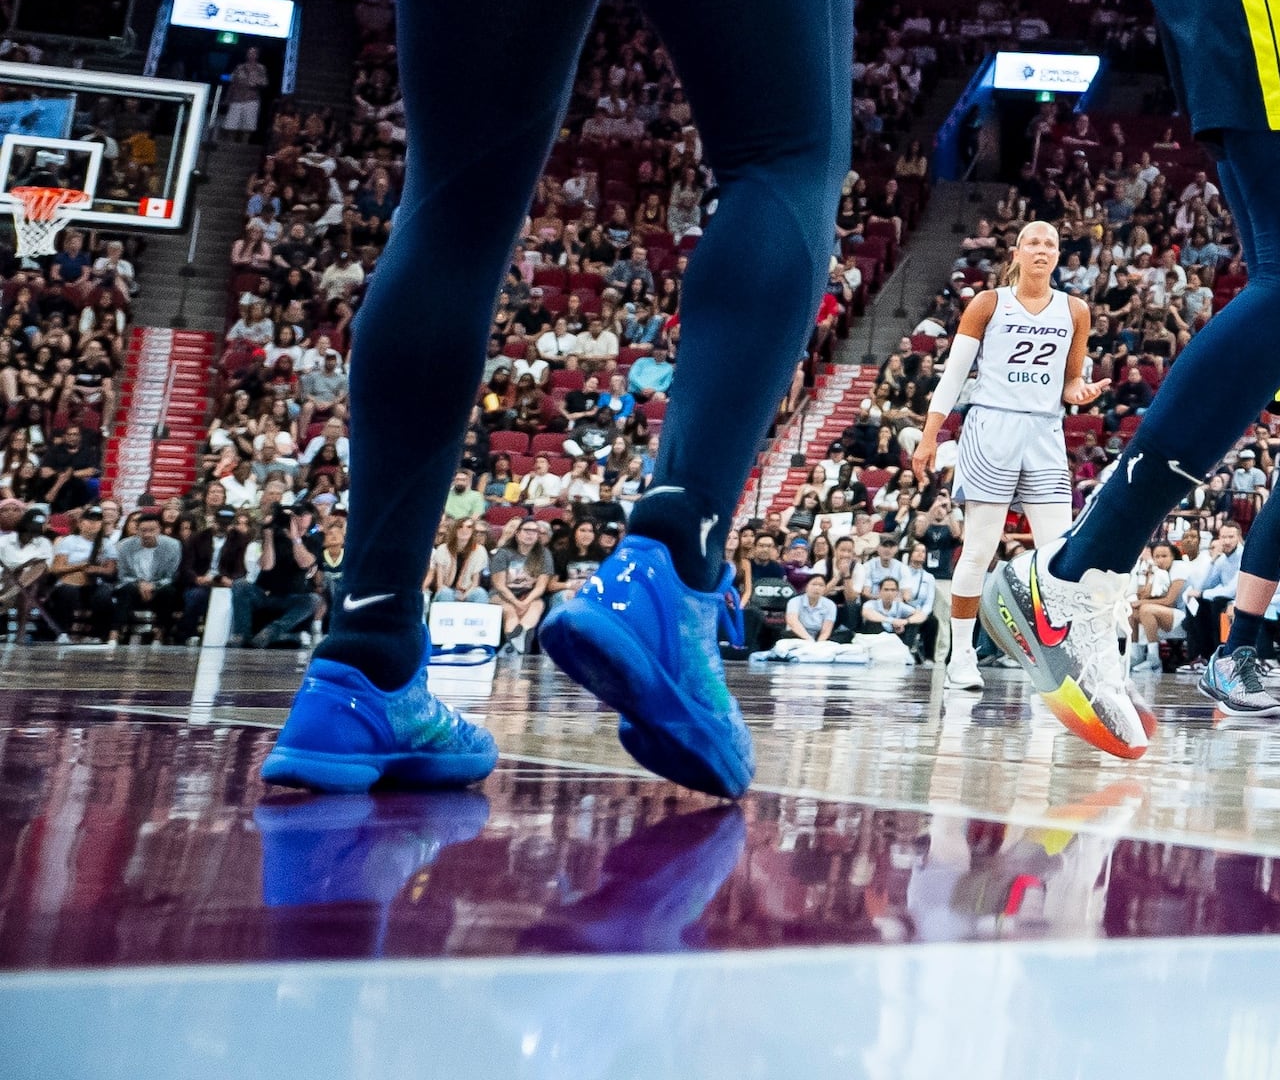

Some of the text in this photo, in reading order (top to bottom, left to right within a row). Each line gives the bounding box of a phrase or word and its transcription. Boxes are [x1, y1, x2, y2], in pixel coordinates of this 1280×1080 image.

[1005, 325, 1068, 338] TEMPO
[1007, 341, 1057, 366] 22
[1008, 372, 1038, 383] CIBC
